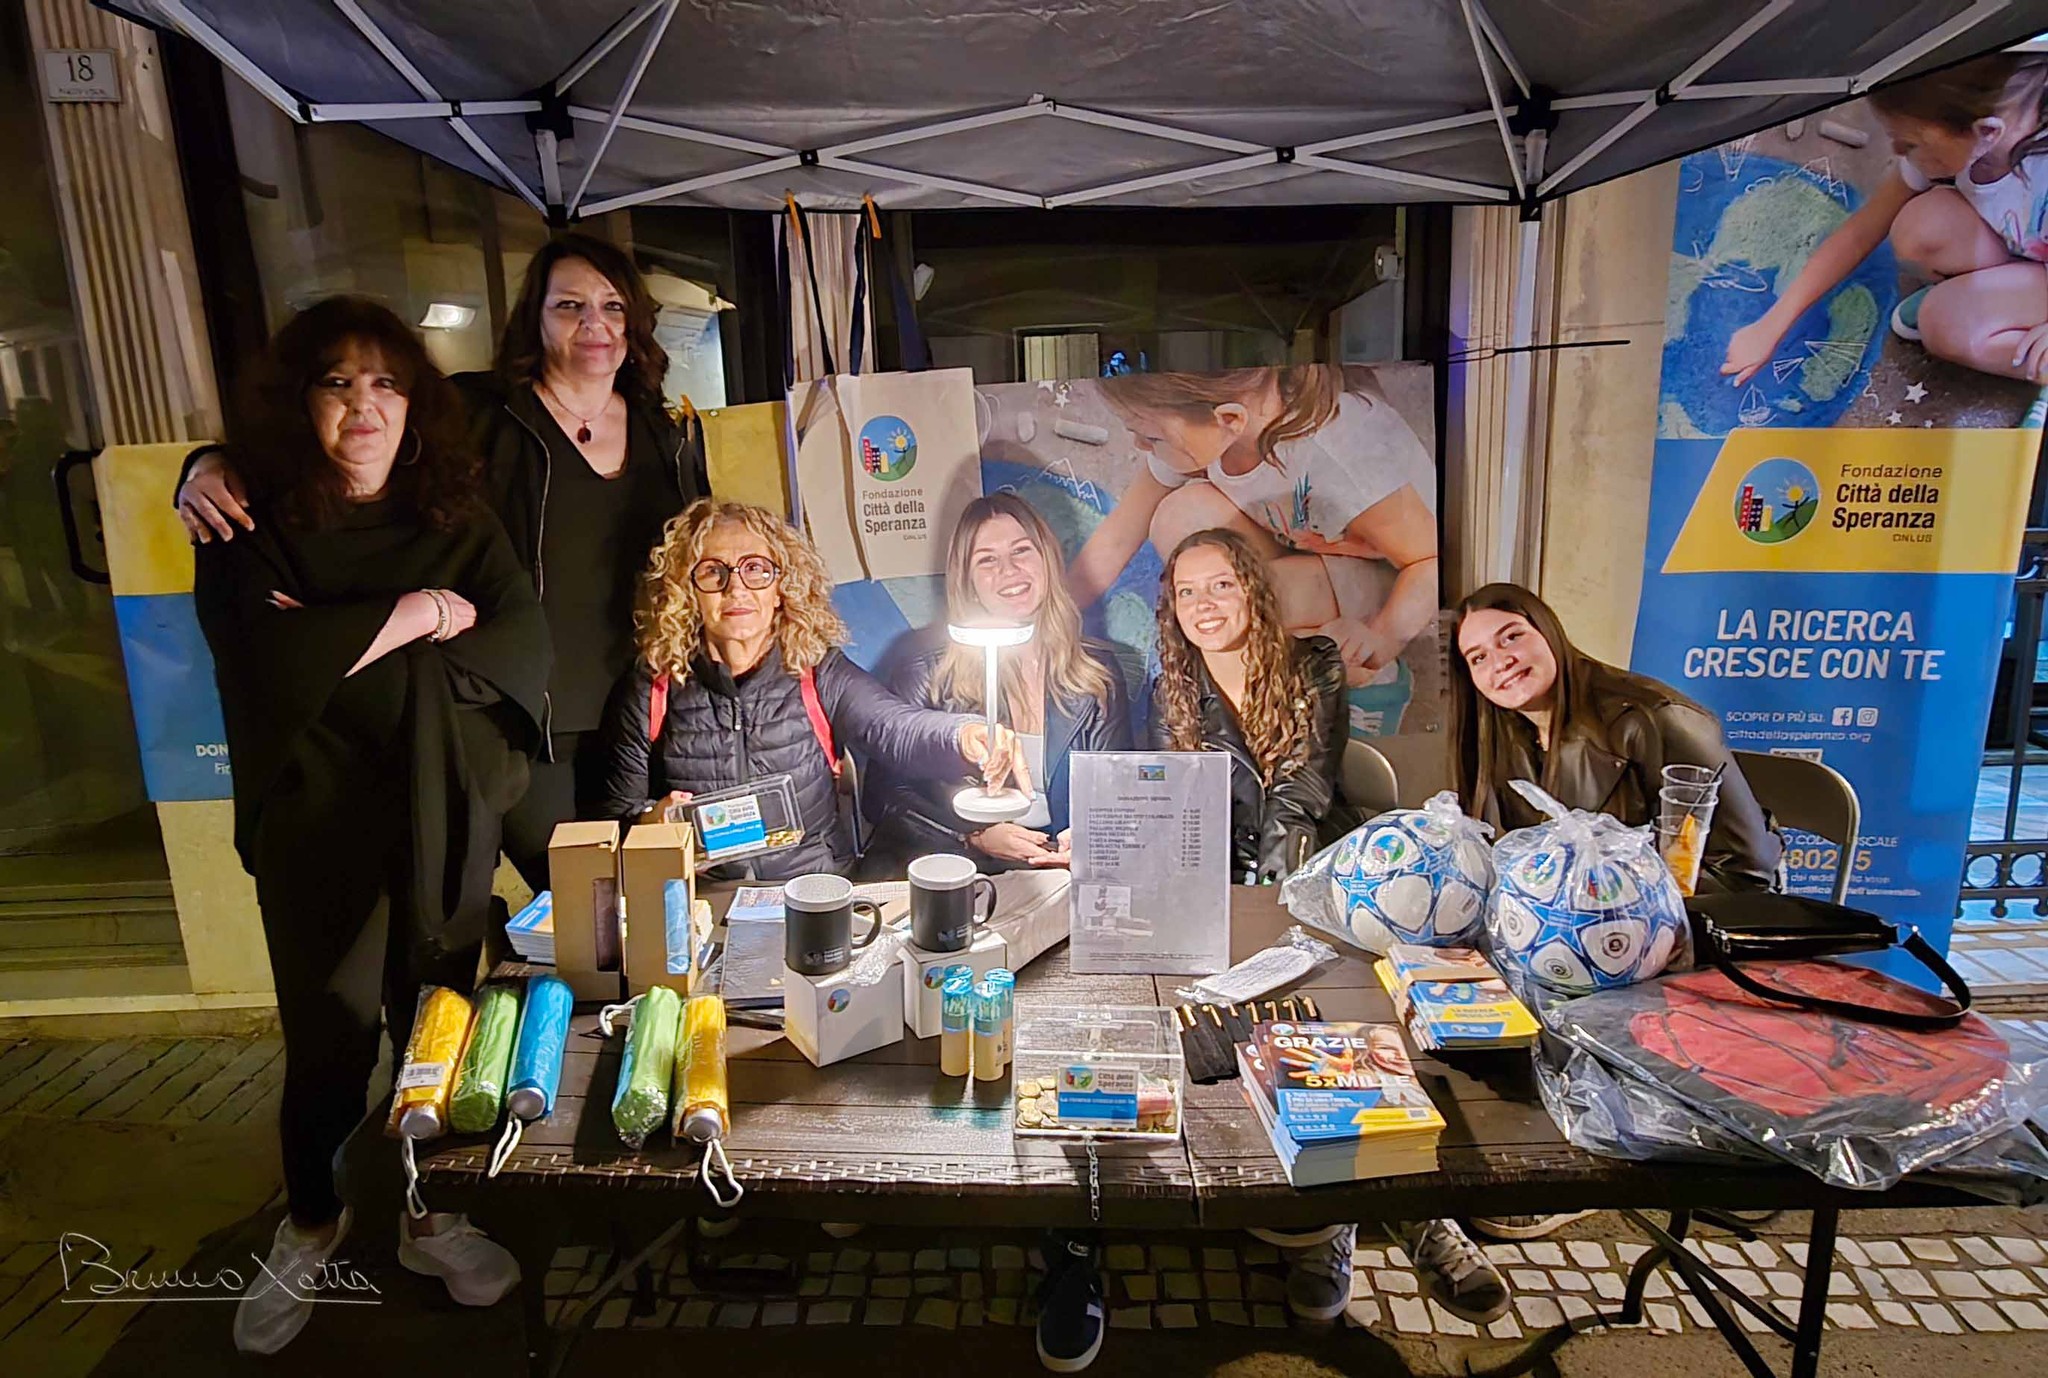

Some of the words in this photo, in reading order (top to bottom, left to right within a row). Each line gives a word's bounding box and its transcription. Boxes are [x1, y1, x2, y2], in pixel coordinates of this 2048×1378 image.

[67, 54, 94, 82] 18
[1840, 463, 1943, 478] Fondazione
[862, 487, 924, 500] Fondazione
[1836, 482, 1882, 503] Città
[1888, 483, 1939, 503] della
[863, 501, 891, 517] Città
[894, 500, 925, 515] della
[864, 517, 927, 535] Speranza
[1831, 506, 1936, 533] Speranza
[1892, 533, 1933, 543] ONLUS
[1716, 608, 1758, 641] LA
[1767, 609, 1916, 642] RICERCA
[1683, 646, 1814, 679] CRESCE
[1819, 648, 1890, 679] CON
[1901, 649, 1946, 681] TE
[1726, 711, 1770, 723] SCOPRI
[1772, 711, 1785, 722] DI
[195, 744, 229, 757] DON
[1857, 836, 1898, 848] SCALE
[1273, 1036, 1368, 1049] GRAZIE
[1304, 1071, 1411, 1088] 5xMILLE
